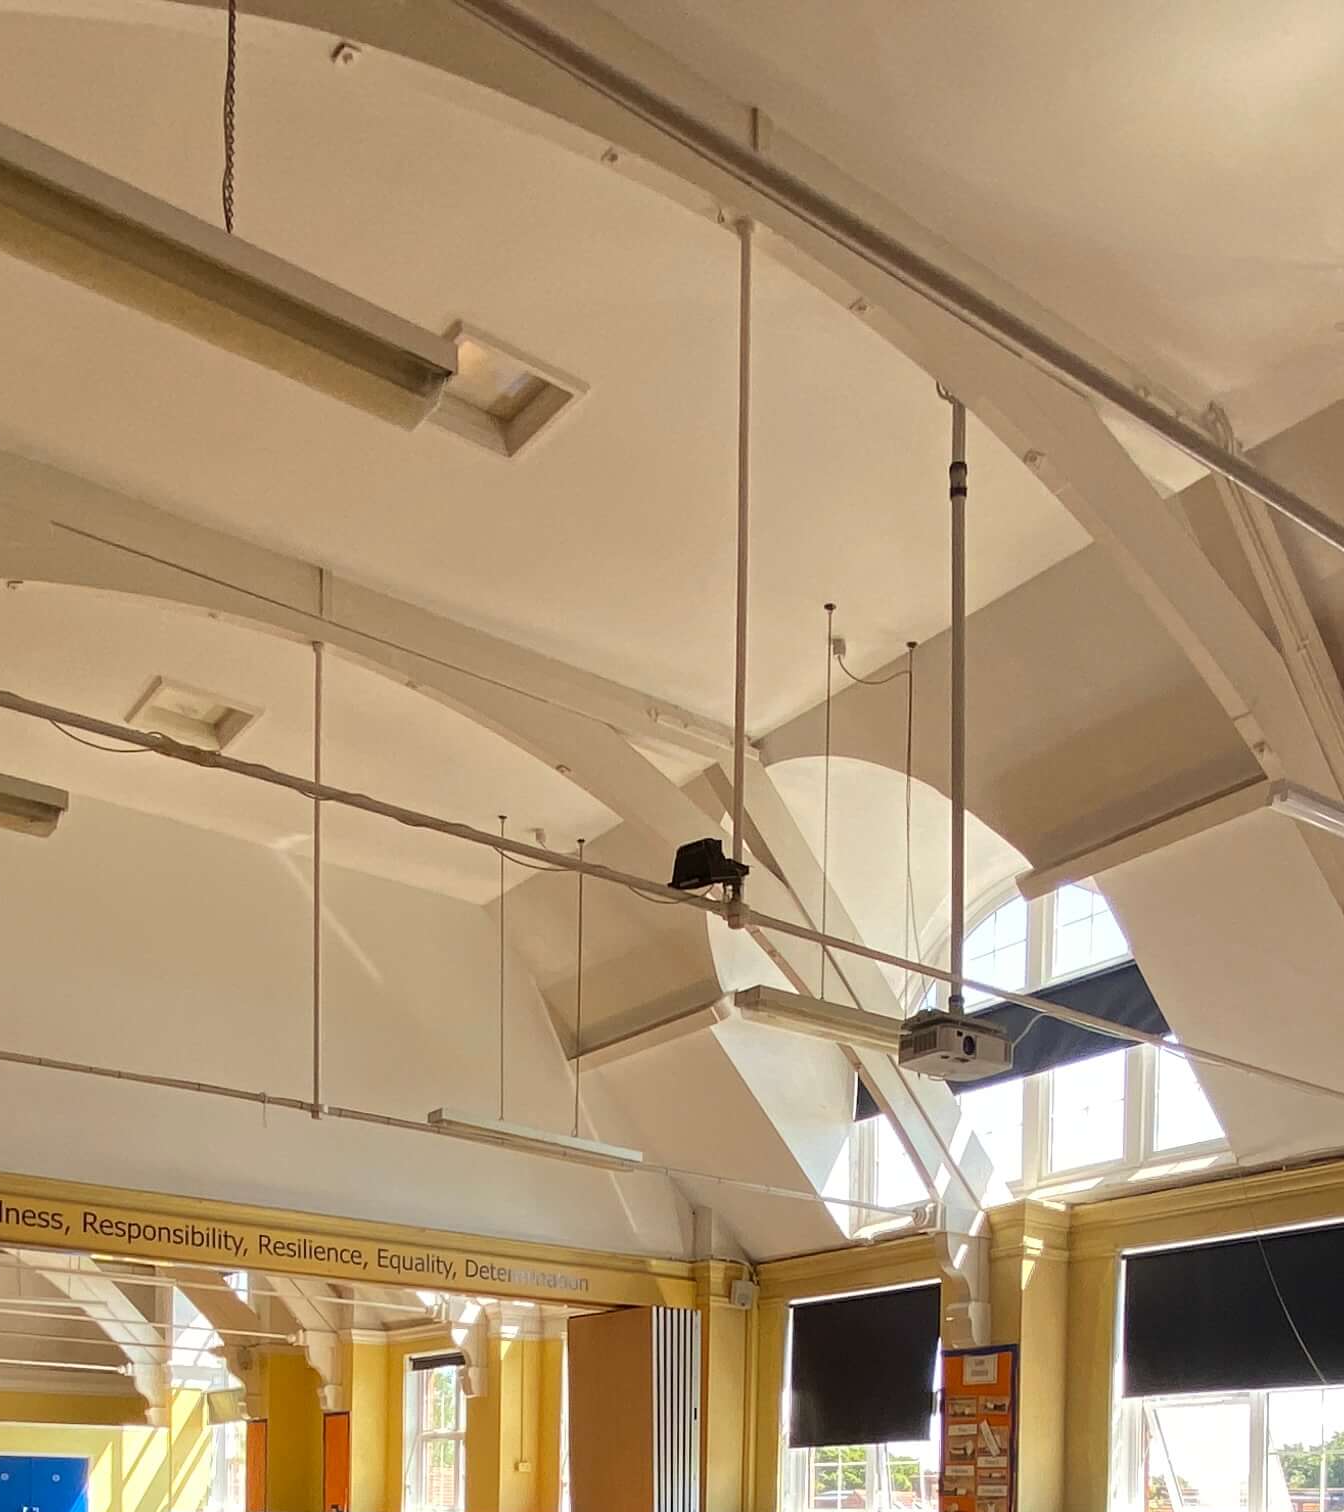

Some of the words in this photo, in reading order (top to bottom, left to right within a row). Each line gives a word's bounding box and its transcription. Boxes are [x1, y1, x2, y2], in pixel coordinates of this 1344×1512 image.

[82, 1211, 248, 1256] Responsibility,
[259, 1234, 369, 1269] Resilience,
[377, 1248, 456, 1281] Equality,
